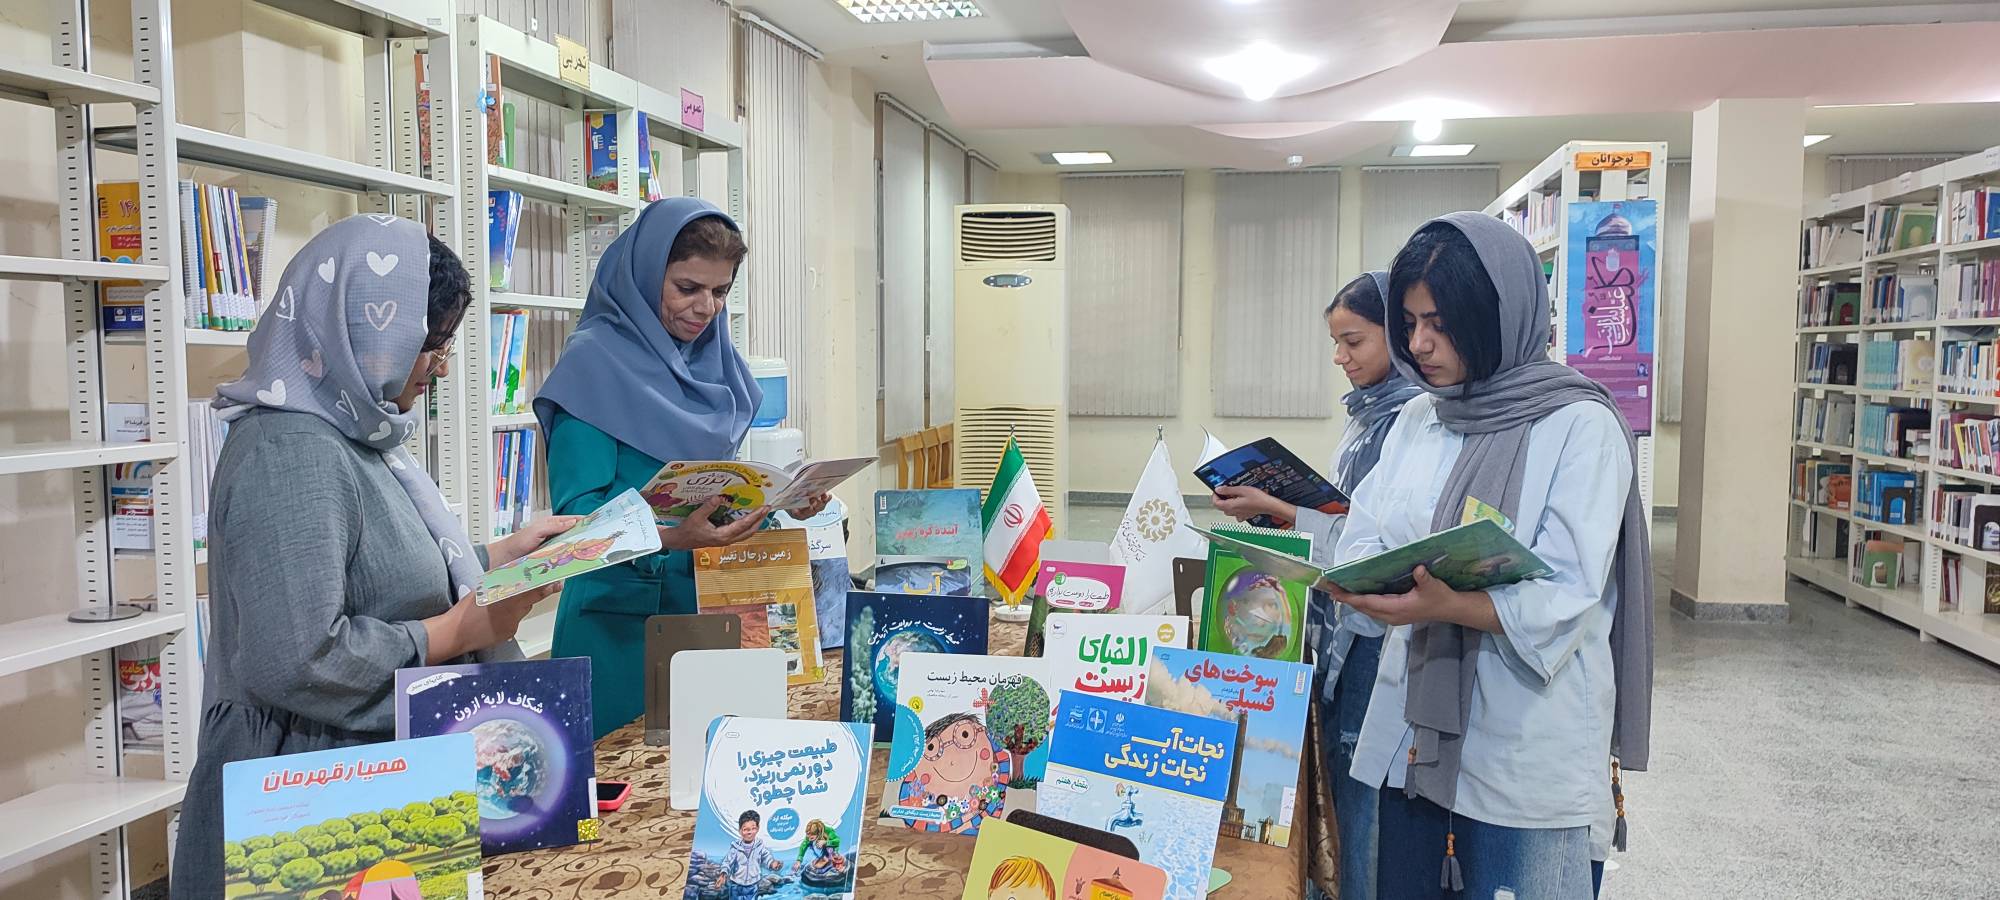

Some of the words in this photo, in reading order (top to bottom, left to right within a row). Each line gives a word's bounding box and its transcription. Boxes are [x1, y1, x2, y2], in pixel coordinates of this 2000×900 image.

[1592, 152, 1634, 167] نوجوانان
[719, 551, 738, 565] تغییر
[770, 548, 791, 561] زمین
[889, 619, 913, 631] روایت
[914, 619, 921, 628] به
[922, 621, 947, 635] زیست
[1079, 633, 1147, 674] الفبای
[927, 671, 958, 685] زیست
[960, 671, 987, 686] محیط
[989, 672, 1022, 689] قهرمان
[1075, 671, 1146, 703] زیست
[453, 696, 481, 722] ازون
[507, 692, 544, 714] شکاف
[1226, 687, 1275, 714] فسیلی
[787, 738, 838, 759] طبیعت
[1130, 727, 1184, 755] آب
[1178, 735, 1226, 763] نجات
[737, 751, 748, 771] را
[748, 750, 786, 768] چیزی
[806, 758, 834, 780] دور
[1103, 744, 1160, 777] زندگی
[1160, 757, 1207, 787] نجات
[749, 784, 796, 807] چطور؟
[797, 777, 829, 796] شما
